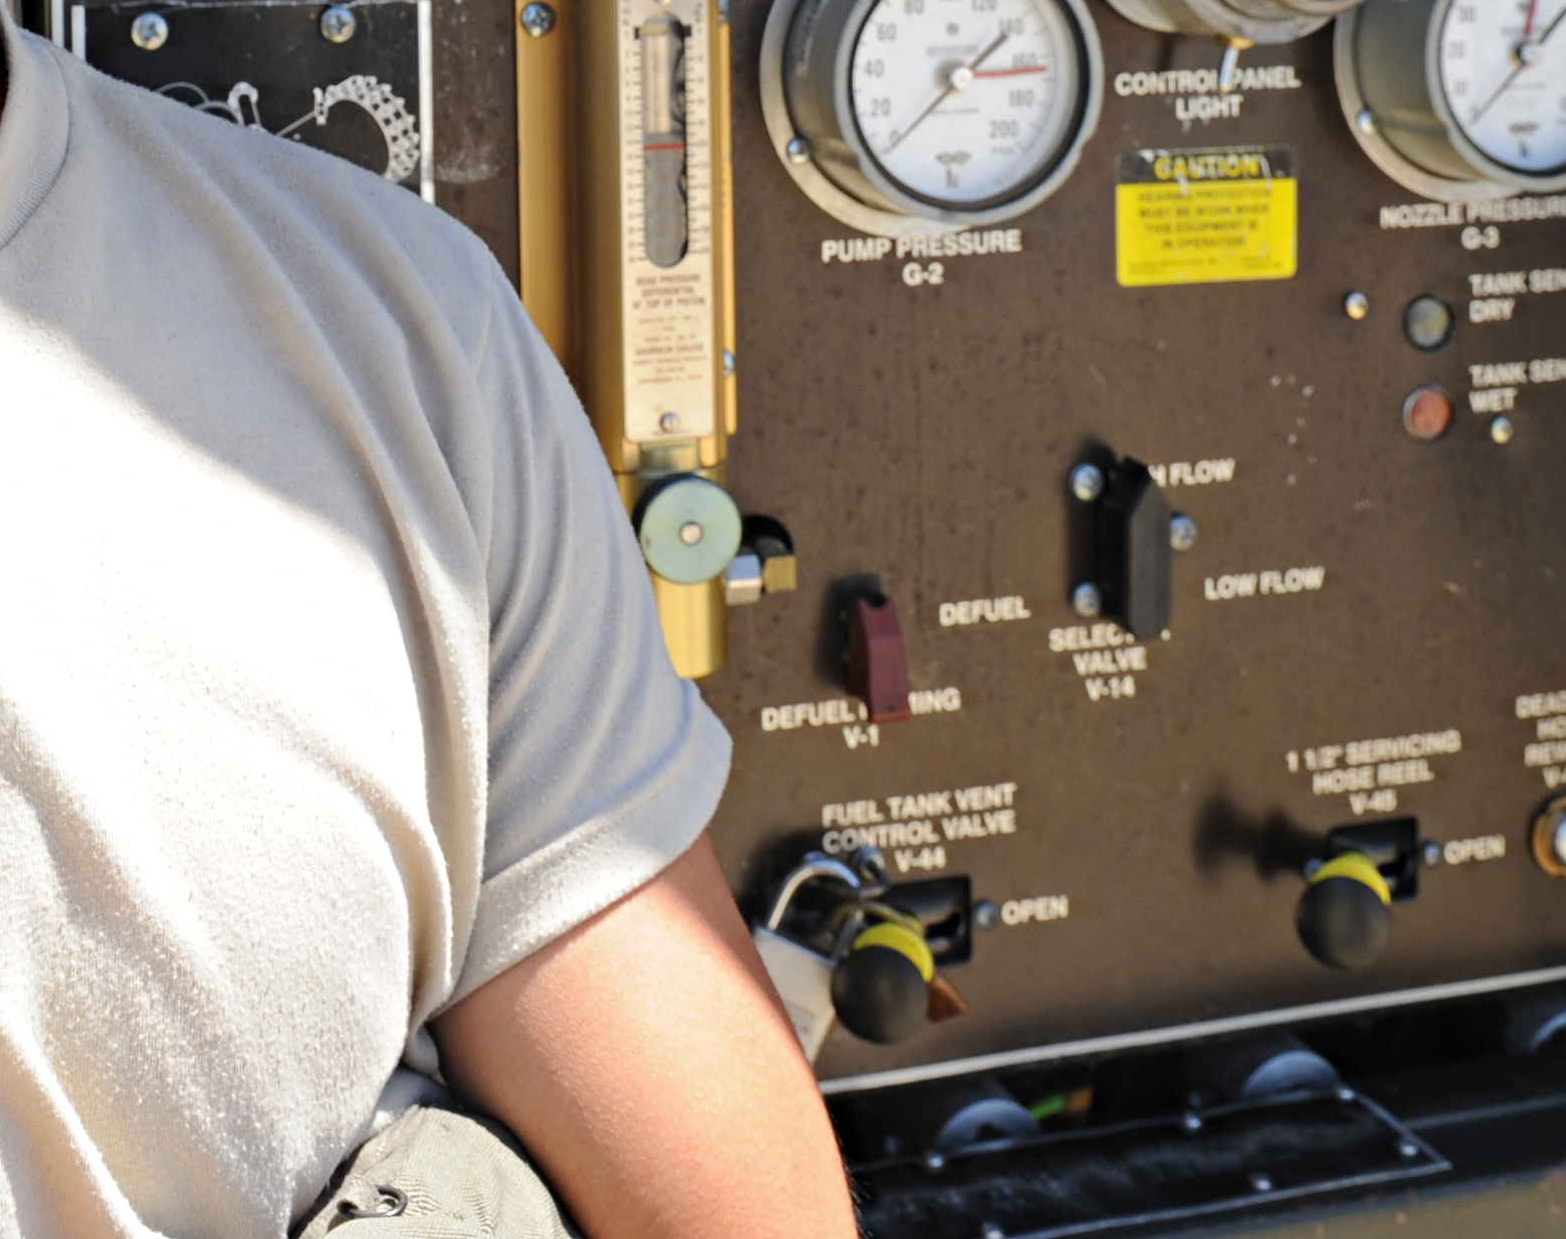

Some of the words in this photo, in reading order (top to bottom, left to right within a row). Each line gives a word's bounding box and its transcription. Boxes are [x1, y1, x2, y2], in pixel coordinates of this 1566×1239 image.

[876, 23, 897, 41] 60
[864, 59, 884, 78] 40
[1231, 66, 1301, 91] PANEL
[870, 98, 891, 117] 20
[1175, 94, 1244, 120] LIGHT
[989, 119, 1019, 139] 200
[1154, 153, 1260, 181] CAUTION
[1380, 201, 1465, 228] NOZZLE
[821, 237, 892, 263] PUMP
[895, 228, 1023, 259] PRESSURE
[1461, 225, 1501, 250] G-3
[902, 261, 945, 287] G-2
[1468, 271, 1529, 297] TANK
[1468, 297, 1516, 323] DRY
[1468, 362, 1529, 387] TANK
[1468, 387, 1518, 413] WET
[1170, 458, 1235, 487] FLOW
[1204, 573, 1258, 601] LOW
[1260, 566, 1325, 595] FLOW
[939, 595, 1031, 627] DEFUEL
[1049, 623, 1172, 652] SELEC
[1073, 646, 1148, 676] VALVE
[1085, 675, 1136, 701] V-14
[761, 699, 856, 732] DEFUEL
[843, 724, 880, 749] V-1
[1345, 728, 1462, 766] SERVICING
[1313, 765, 1376, 796] HOSE
[1377, 759, 1435, 788] REEL
[822, 799, 884, 828] FUEL
[886, 791, 952, 819] TANK
[954, 782, 1017, 812] VENT
[823, 821, 940, 854] CONTROL
[942, 809, 1016, 841] VALVE
[894, 846, 947, 873] V-44
[1444, 834, 1506, 865] OPEN
[1001, 894, 1069, 926] OPEN
